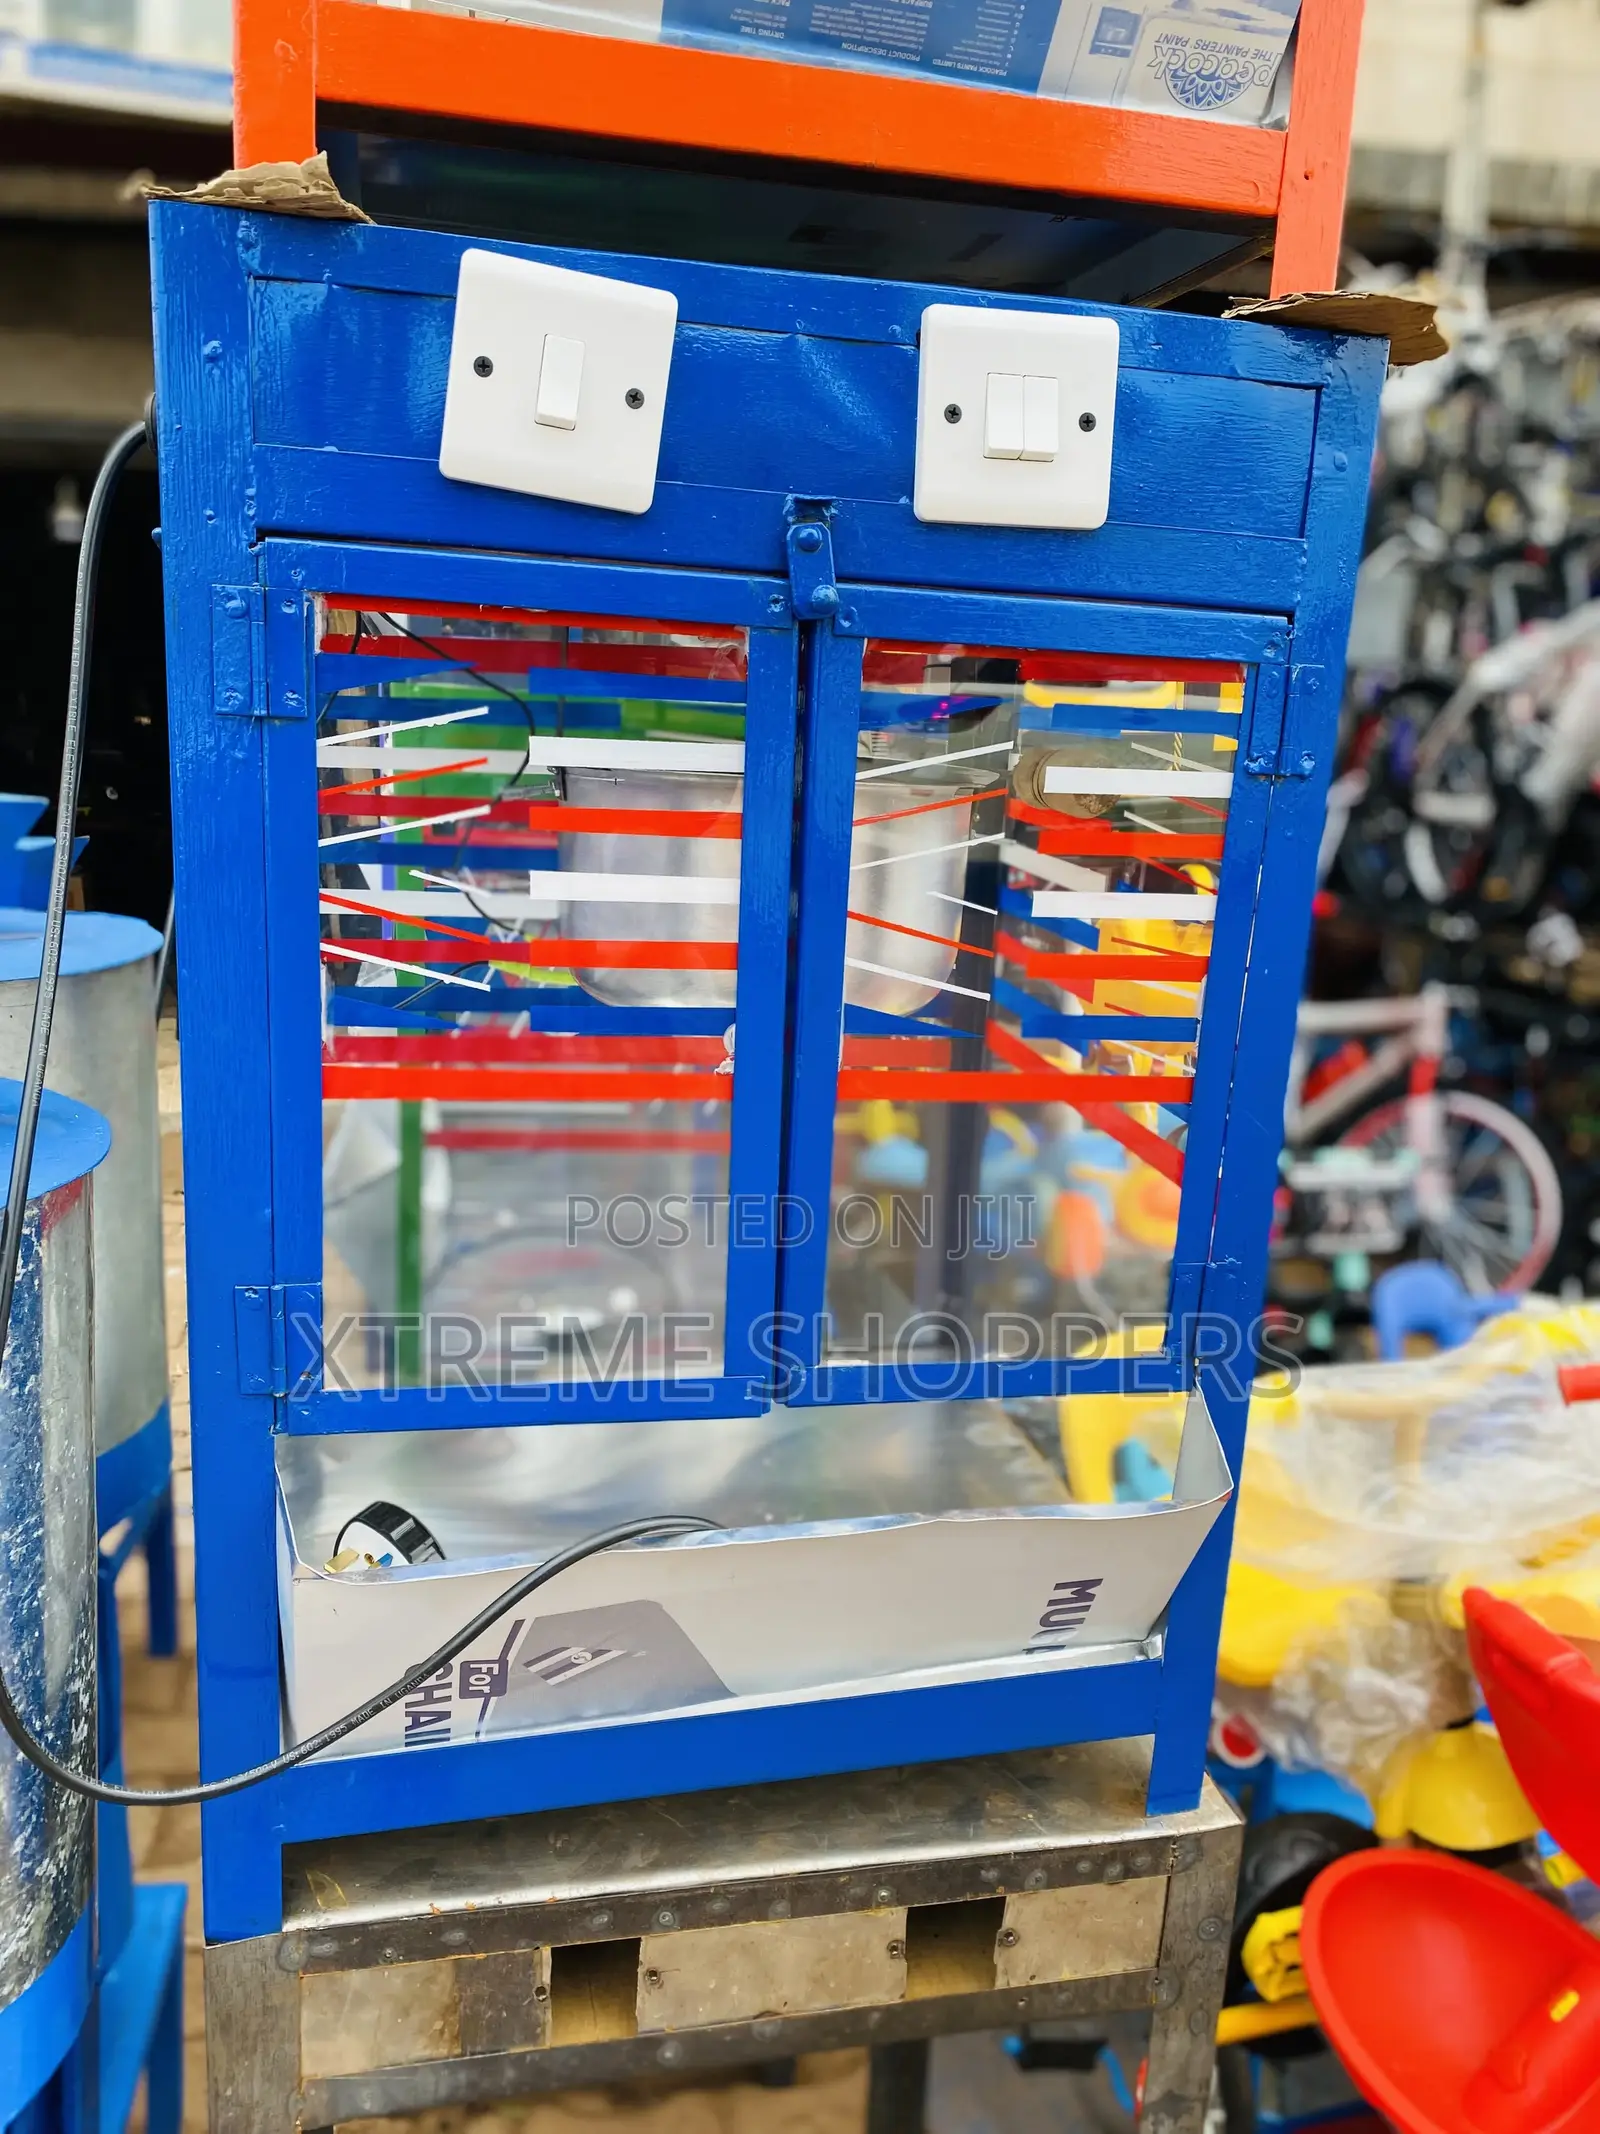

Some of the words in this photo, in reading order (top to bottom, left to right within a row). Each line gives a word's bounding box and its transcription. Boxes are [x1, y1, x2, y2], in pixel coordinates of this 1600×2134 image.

[740, 25, 757, 35] TIME
[758, 28, 785, 39] DRYING
[1154, 32, 1191, 47] PAINT
[841, 41, 887, 56] DESCRIPTION
[887, 50, 921, 62] PRODUCT
[1251, 51, 1273, 62] THE
[932, 58, 957, 69] LIMITED
[977, 66, 1008, 77] PEACOCK
[1146, 44, 1284, 88] peacock
[71, 602, 82, 668] INSULATED
[67, 674, 79, 732] FLEXIBLE
[63, 739, 76, 797] ELECTRIC
[59, 804, 72, 846] CABLES
[40, 1006, 52, 1036] MADE
[469, 1663, 499, 1694] For
[350, 1708, 376, 1727] MADE
[379, 1698, 393, 1710] IN
